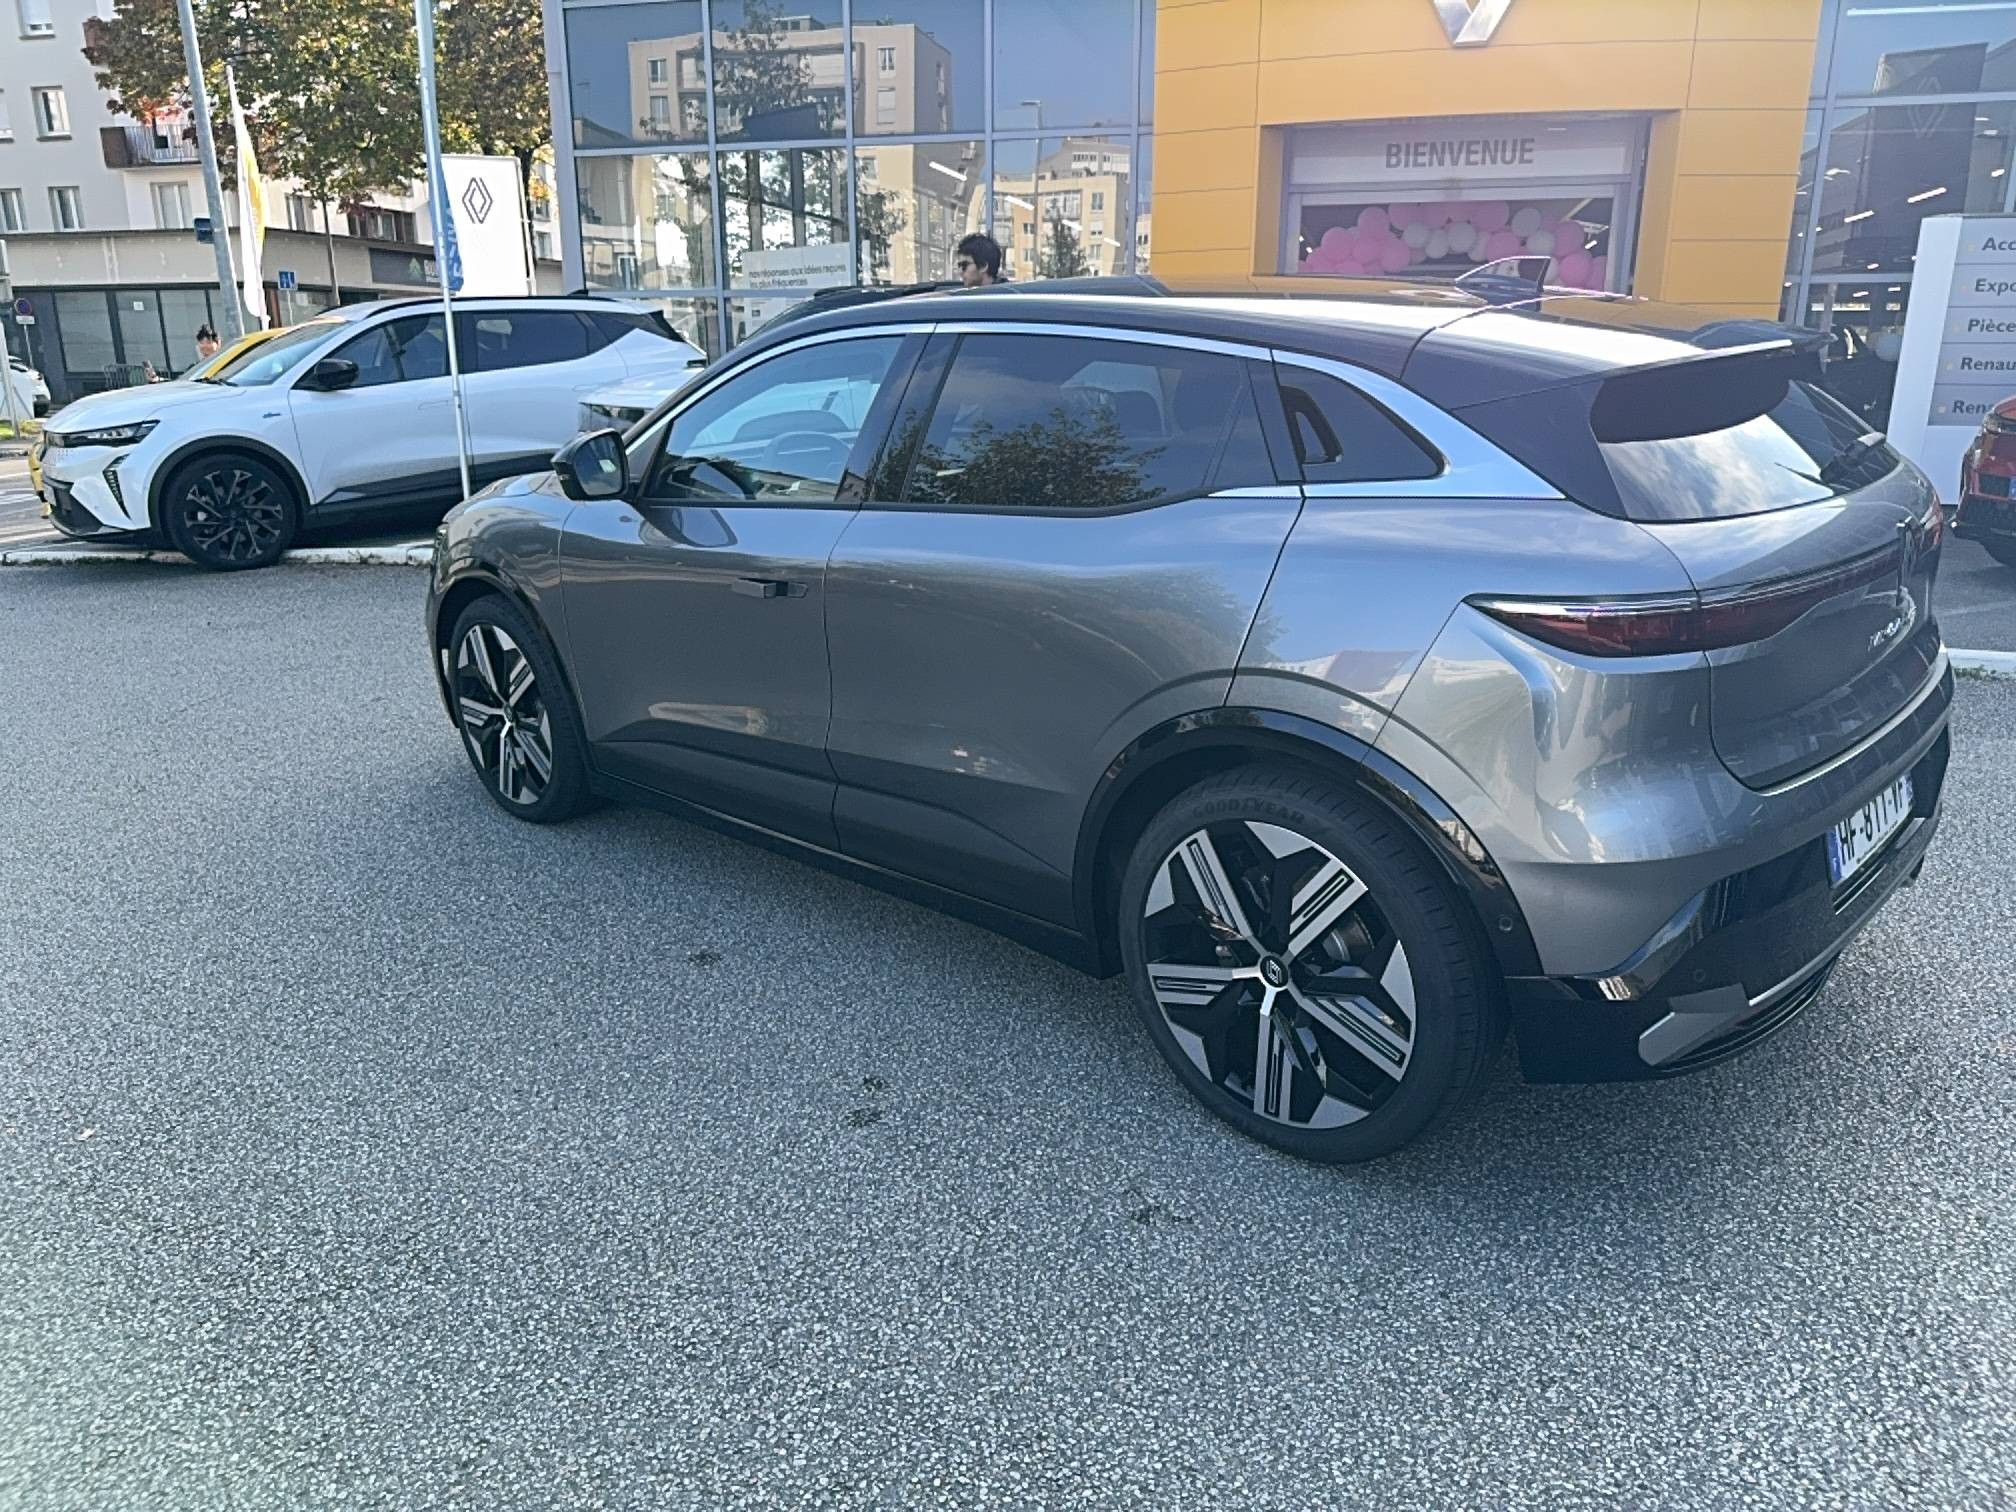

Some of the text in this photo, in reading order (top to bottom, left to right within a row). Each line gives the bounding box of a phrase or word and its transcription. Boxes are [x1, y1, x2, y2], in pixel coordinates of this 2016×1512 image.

[1385, 138, 1535, 169] BIENVENUE
[1981, 237, 2016, 251] Acc
[1974, 278, 2016, 296] Expo
[1967, 317, 2016, 333] Pièce
